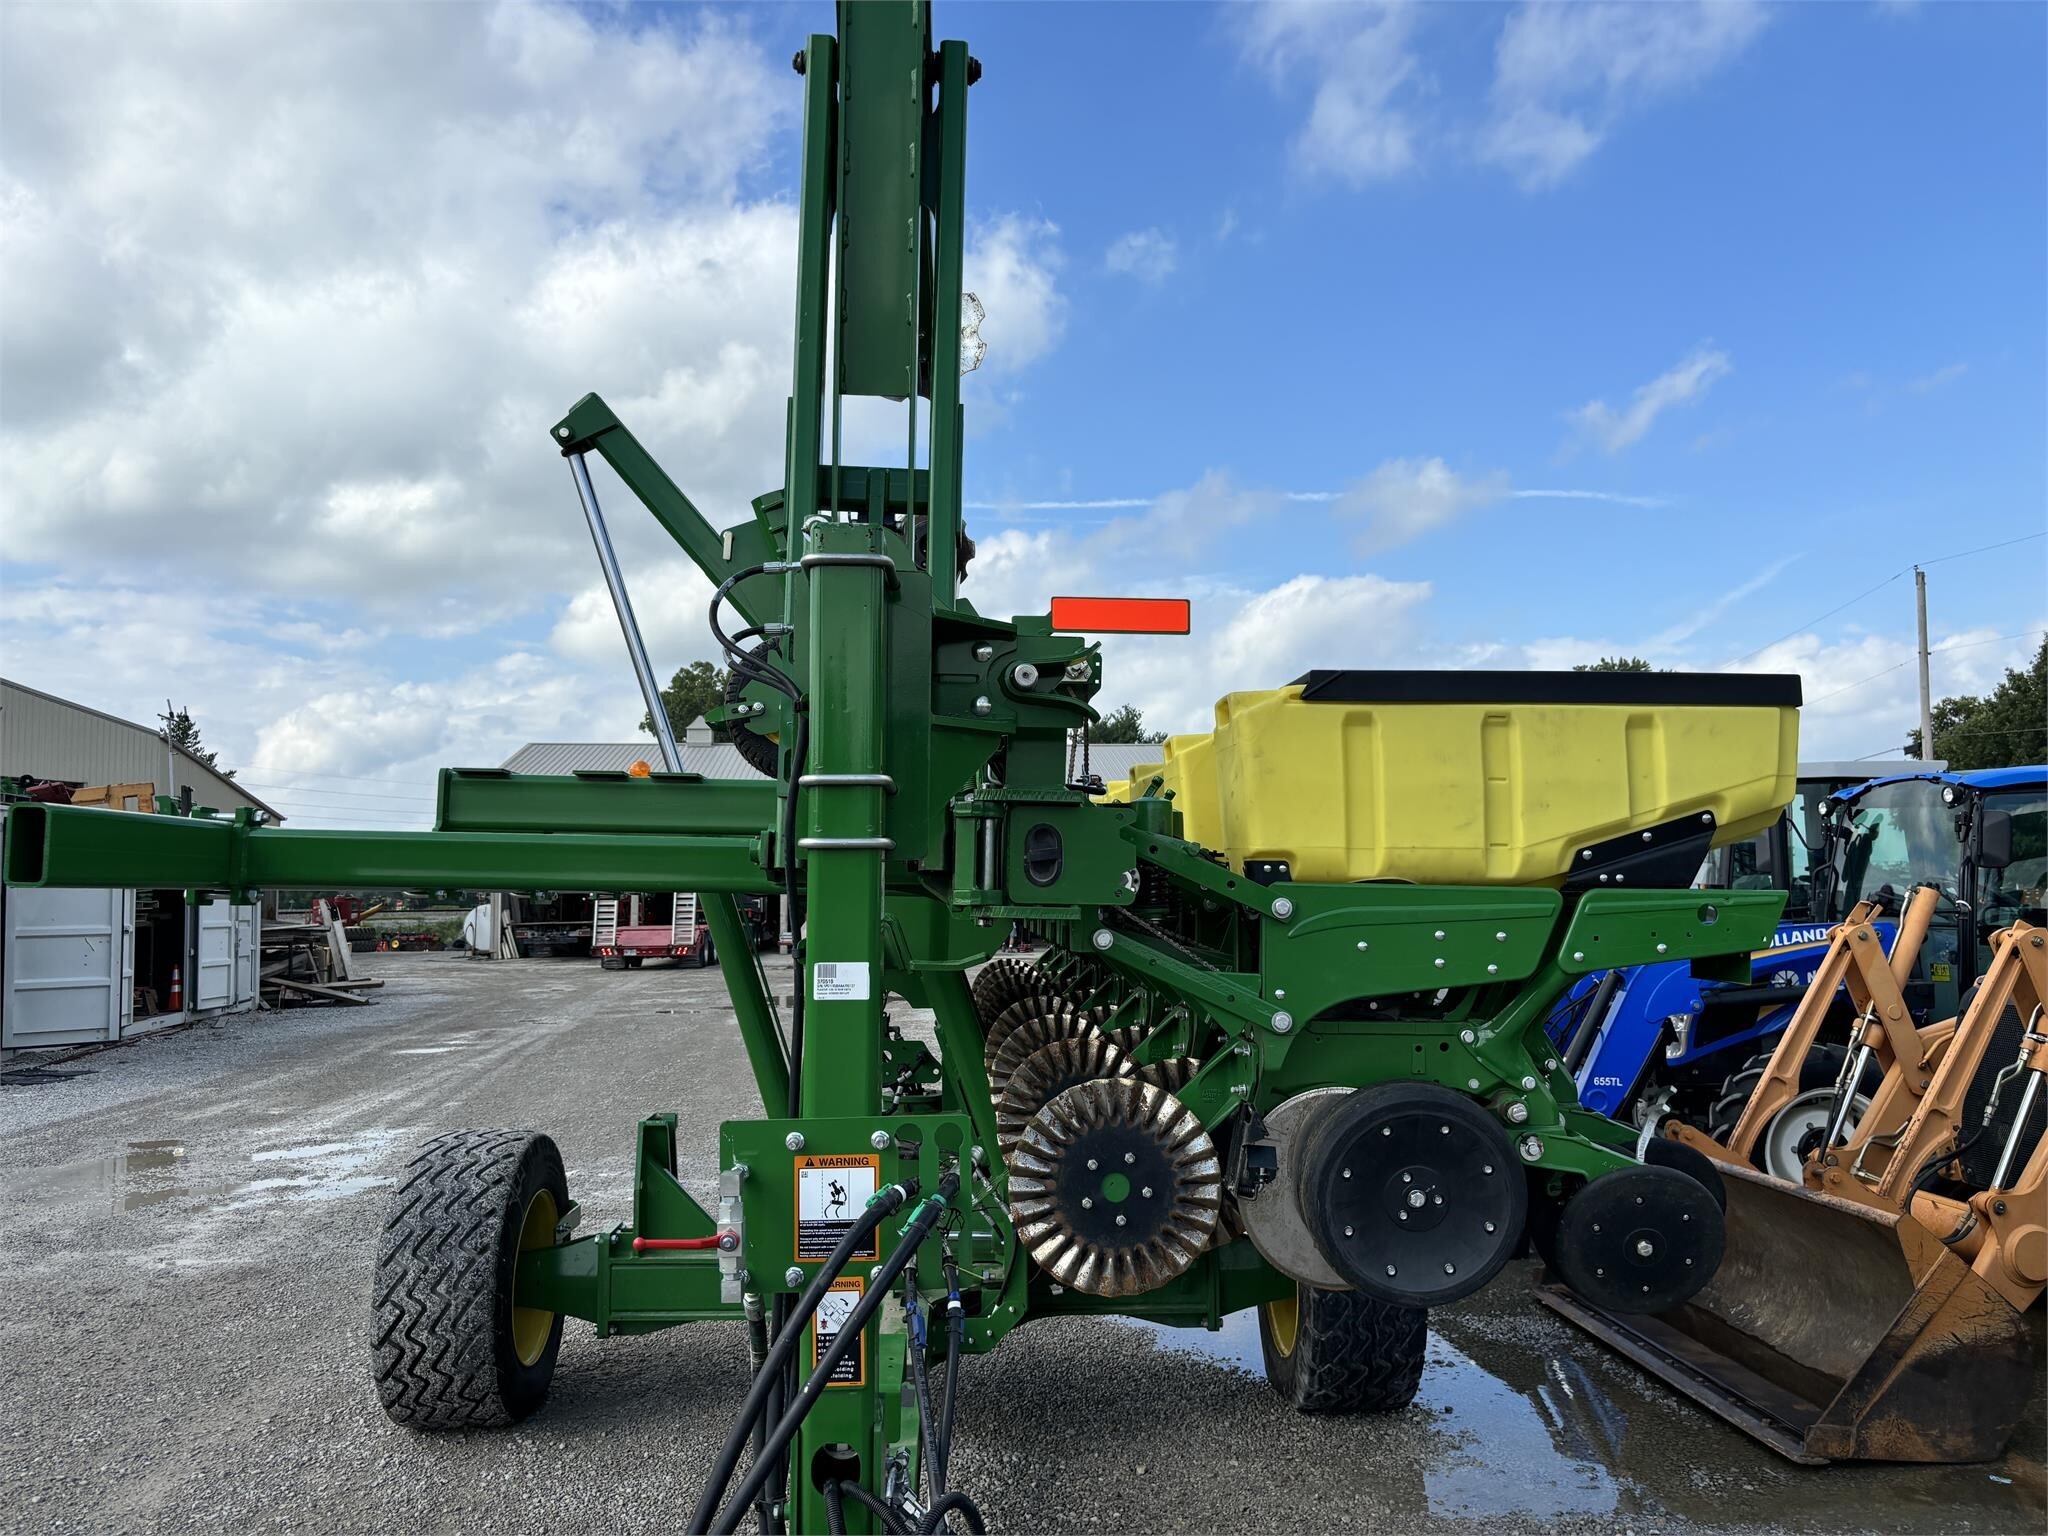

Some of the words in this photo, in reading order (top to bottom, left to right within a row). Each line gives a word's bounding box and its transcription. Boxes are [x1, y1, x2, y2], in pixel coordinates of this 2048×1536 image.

[1770, 928, 1828, 948] LLAND
[1593, 1076, 1624, 1087] 655TL
[818, 1156, 870, 1167] WARNING
[830, 1280, 861, 1288] ARNING
